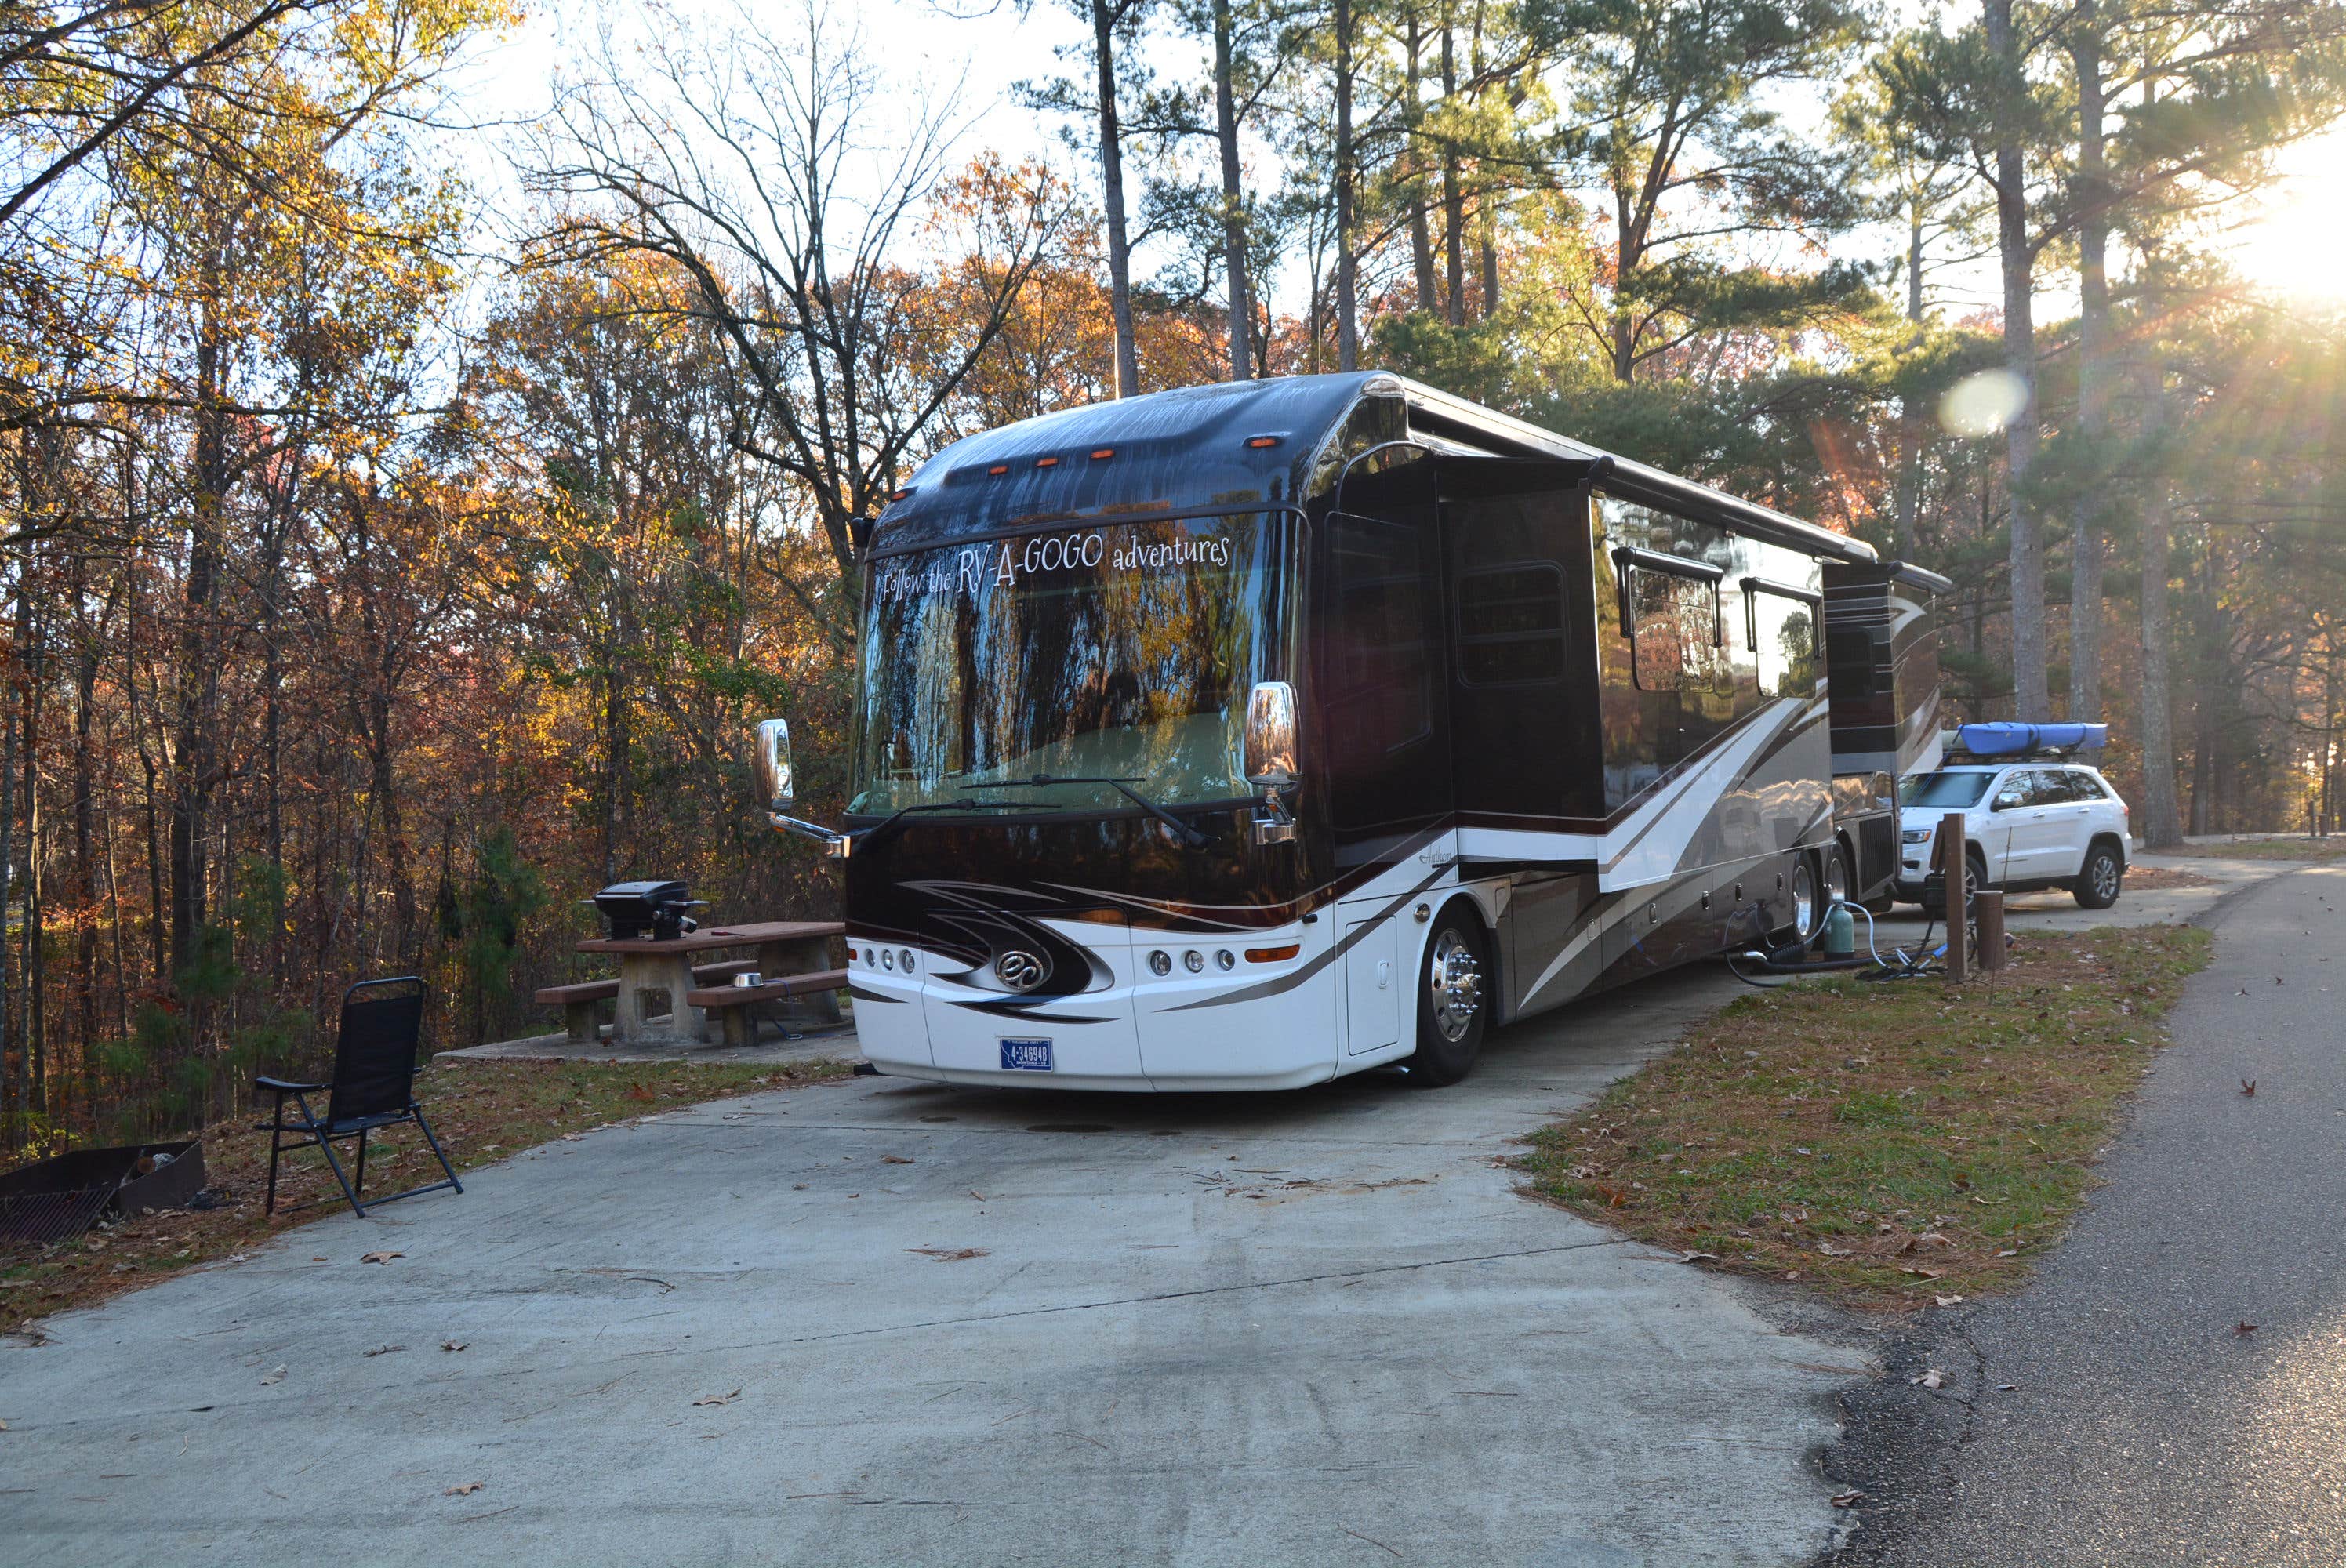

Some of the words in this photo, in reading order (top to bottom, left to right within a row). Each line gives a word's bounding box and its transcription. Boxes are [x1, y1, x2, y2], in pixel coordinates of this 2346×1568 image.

[883, 568, 924, 601] Follow
[928, 560, 951, 593] the
[957, 533, 1103, 593] RV-A-GOGO
[1113, 535, 1230, 570] adventures
